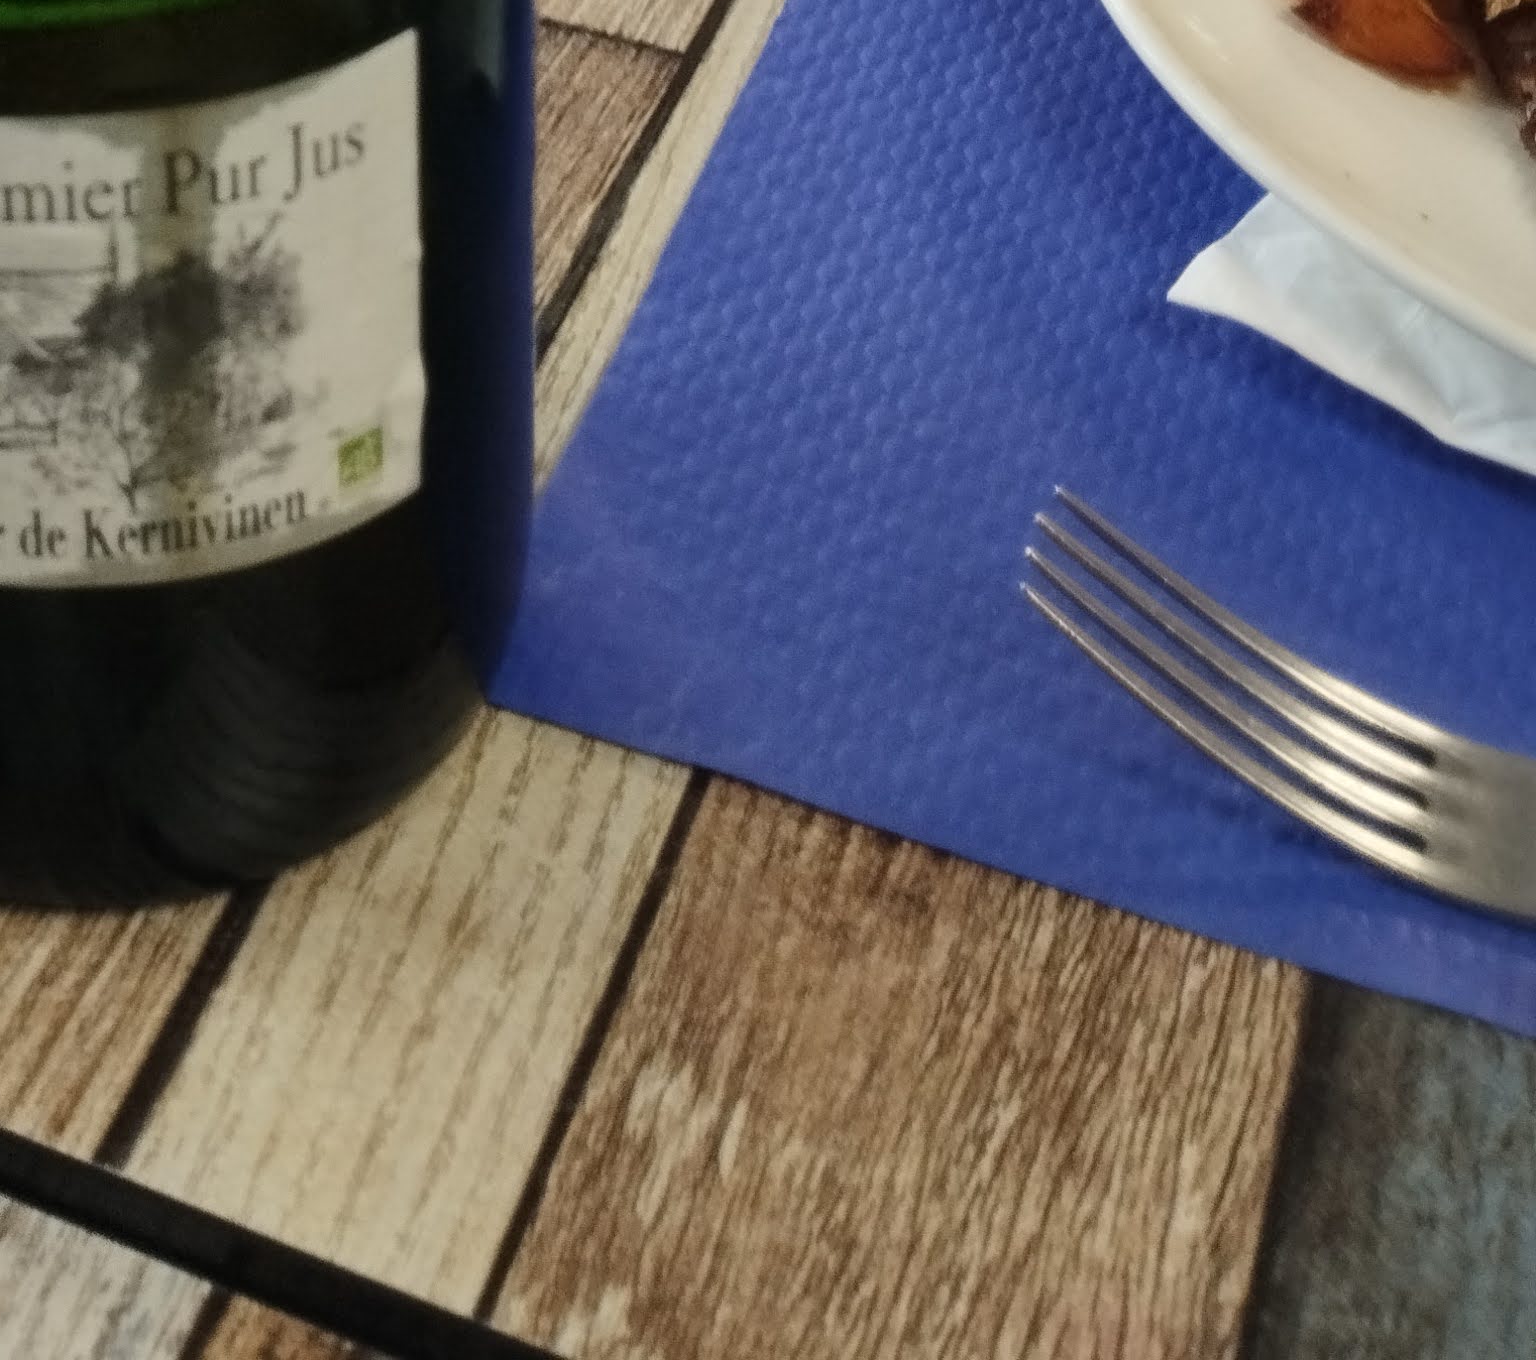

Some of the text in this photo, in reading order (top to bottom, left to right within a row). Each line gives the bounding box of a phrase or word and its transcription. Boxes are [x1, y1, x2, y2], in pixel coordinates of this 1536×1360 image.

[163, 144, 268, 216] Pur
[281, 120, 367, 204] Jus
[18, 506, 68, 560] de
[81, 487, 309, 564] Kernivinen
